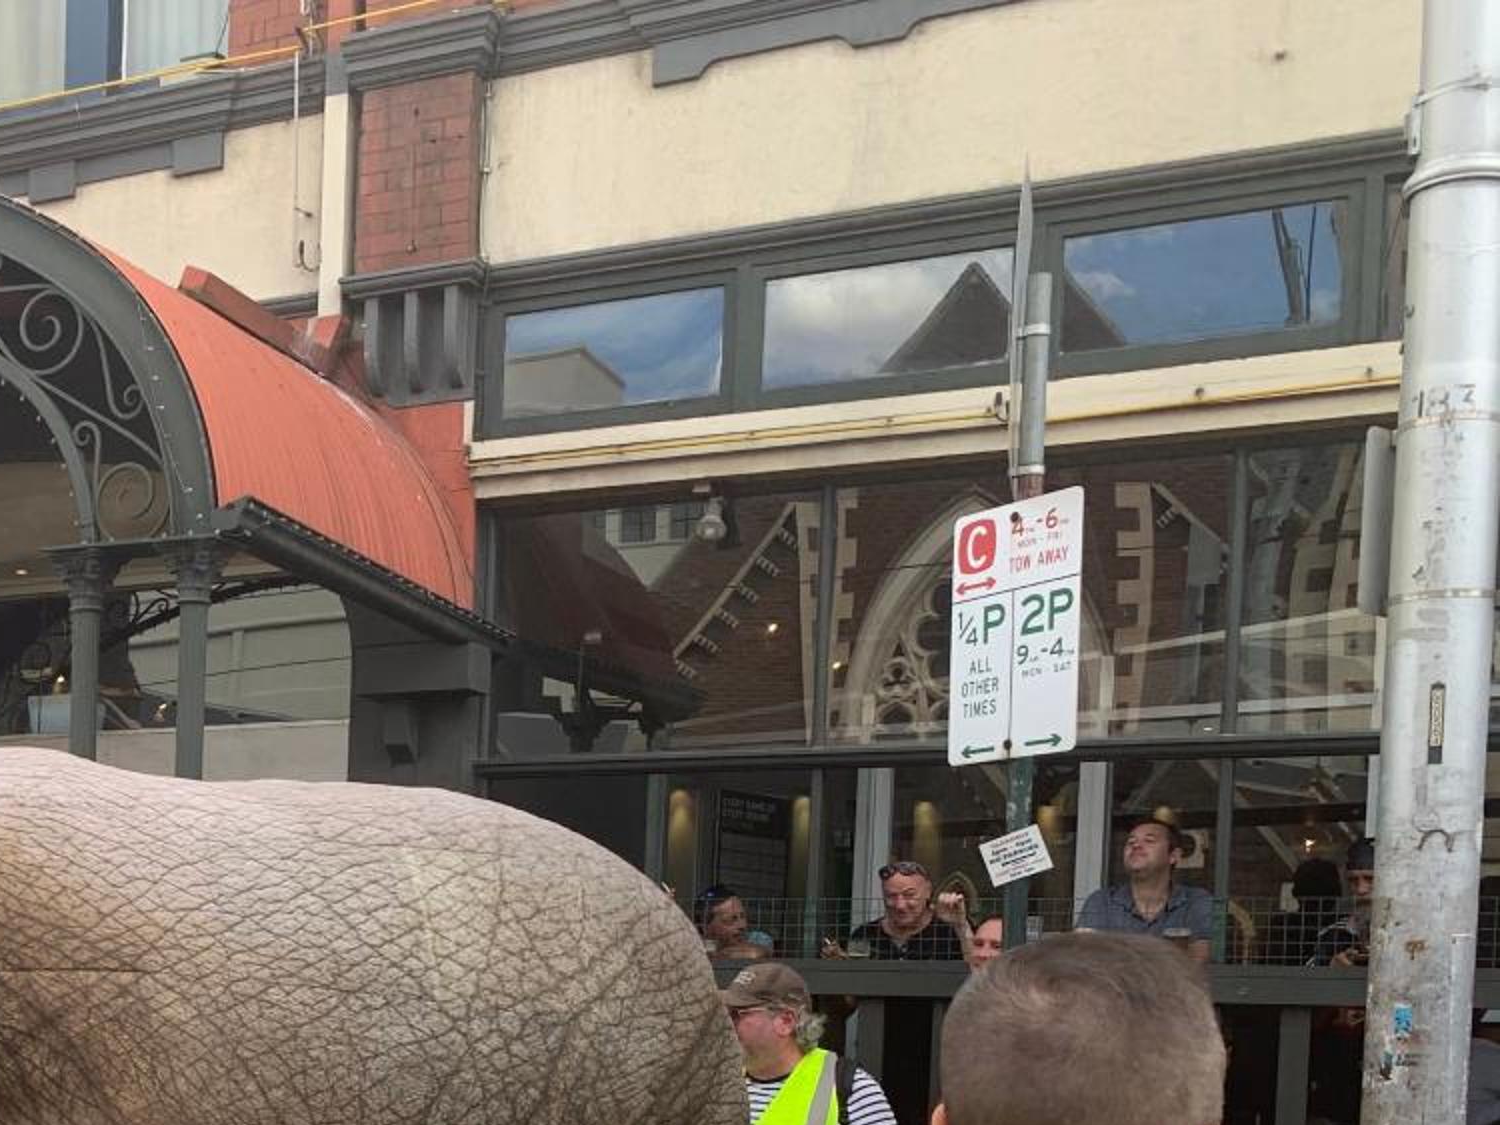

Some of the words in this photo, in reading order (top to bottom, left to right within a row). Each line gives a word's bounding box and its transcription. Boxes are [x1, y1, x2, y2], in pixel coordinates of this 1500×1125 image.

[1009, 554, 1031, 574] TOW
[1037, 545, 1070, 567] AWAY
[1020, 587, 1075, 636] 2P
[969, 656, 993, 675] ALL
[961, 677, 999, 698] OTHER
[963, 699, 997, 719] TIMES
